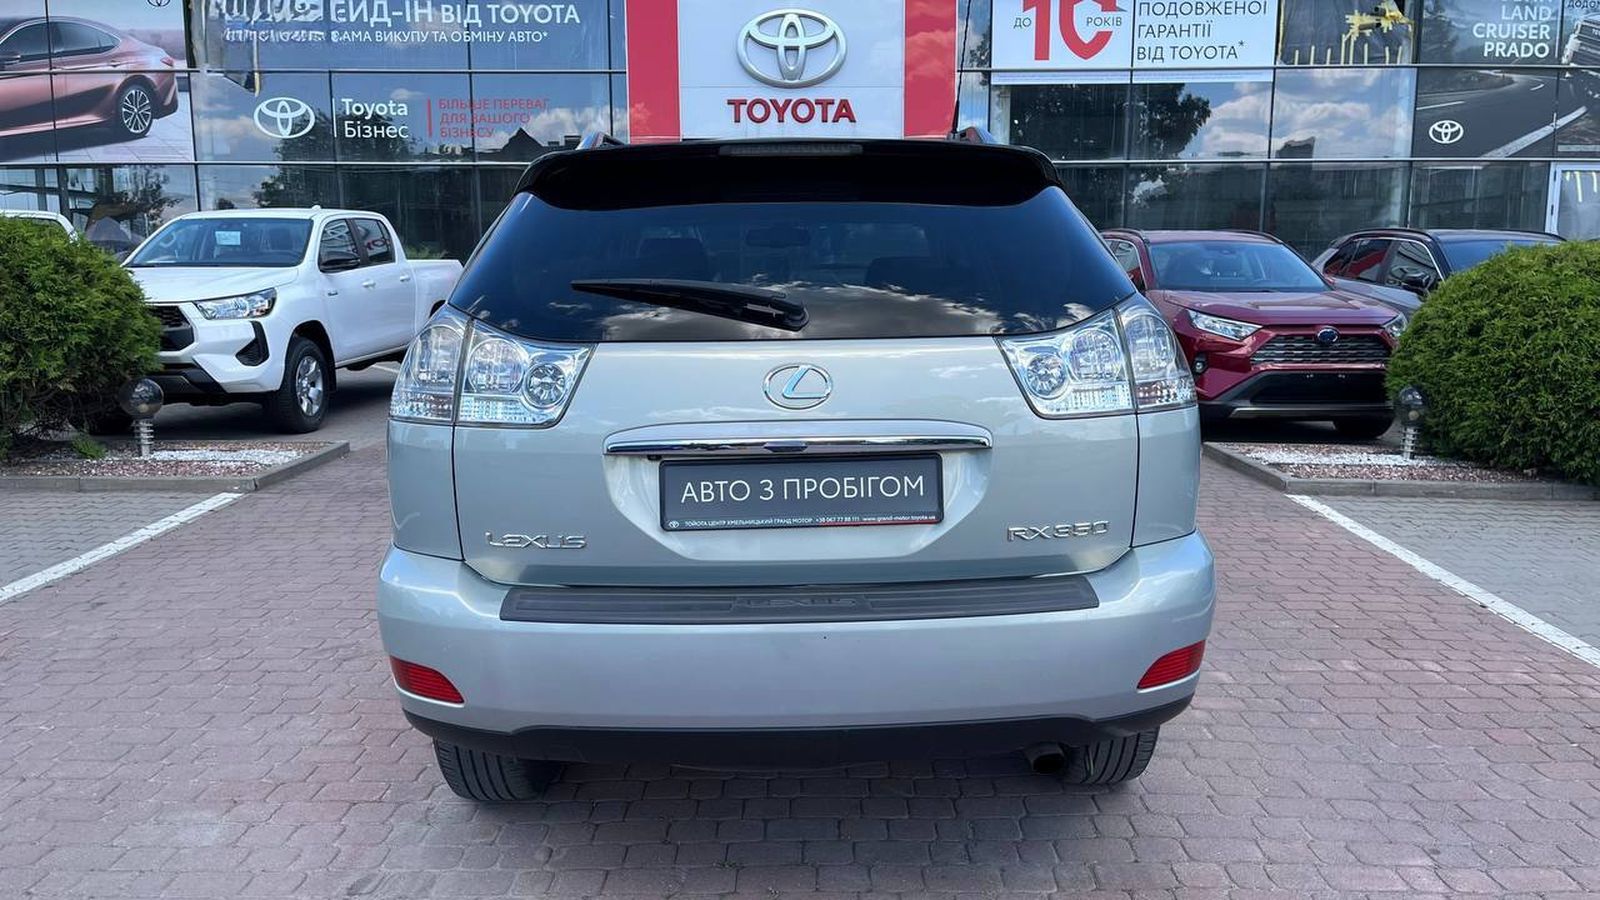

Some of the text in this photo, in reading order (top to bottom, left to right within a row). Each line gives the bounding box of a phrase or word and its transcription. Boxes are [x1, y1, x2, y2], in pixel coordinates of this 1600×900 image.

[441, 4, 482, 27] ВІД
[487, 4, 580, 24] TOYOTA
[1501, 5, 1552, 21] LAND
[1013, 17, 1032, 28] ДО
[1086, 16, 1122, 27] РОКІВ
[1138, 20, 1213, 38] ГАРАНТІЇ
[375, 31, 428, 42] ВИКУПУ
[431, 31, 448, 42] ТА
[451, 31, 505, 42] ОБМІНУ
[1472, 23, 1551, 39] CRUISER
[1137, 46, 1164, 62] ВІД
[1483, 42, 1550, 58] PRADO
[341, 98, 408, 119] Toyota
[438, 98, 549, 110] БІЛЬШЕ ПЕРЕВАГ
[727, 98, 857, 124] TOYOTA
[440, 112, 531, 125] ДЛЯ ВАШОГО
[345, 121, 409, 138] Бізнес
[440, 126, 494, 138] БІЗНЕСУ
[681, 480, 750, 503] АВТО
[784, 475, 925, 500] ПРОБІГОМ
[485, 532, 587, 549] LEXUS
